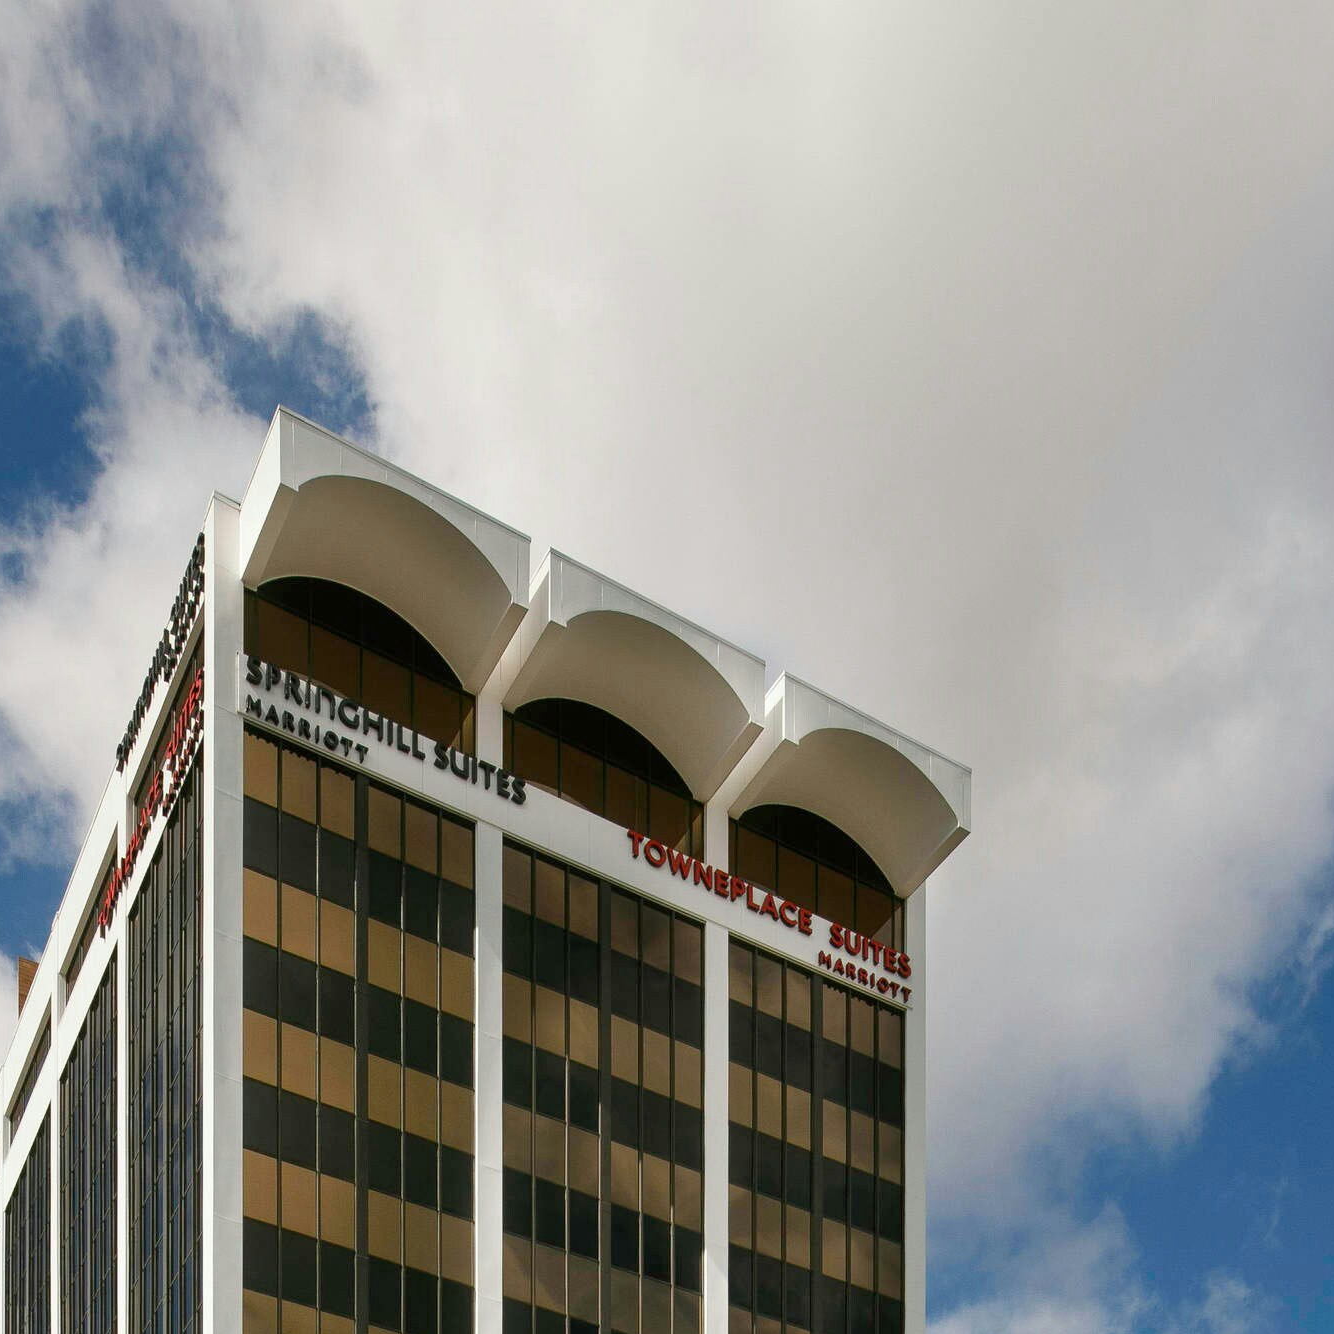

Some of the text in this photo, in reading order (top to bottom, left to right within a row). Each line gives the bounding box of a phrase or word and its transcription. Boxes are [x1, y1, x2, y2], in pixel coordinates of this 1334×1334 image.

[246, 695, 369, 764] MARRIOTT
[246, 655, 527, 805] SPRINGHILL SUITES
[627, 829, 912, 979] TOWNEPLACE SUITES
[818, 951, 912, 1003] MARRIOTT
